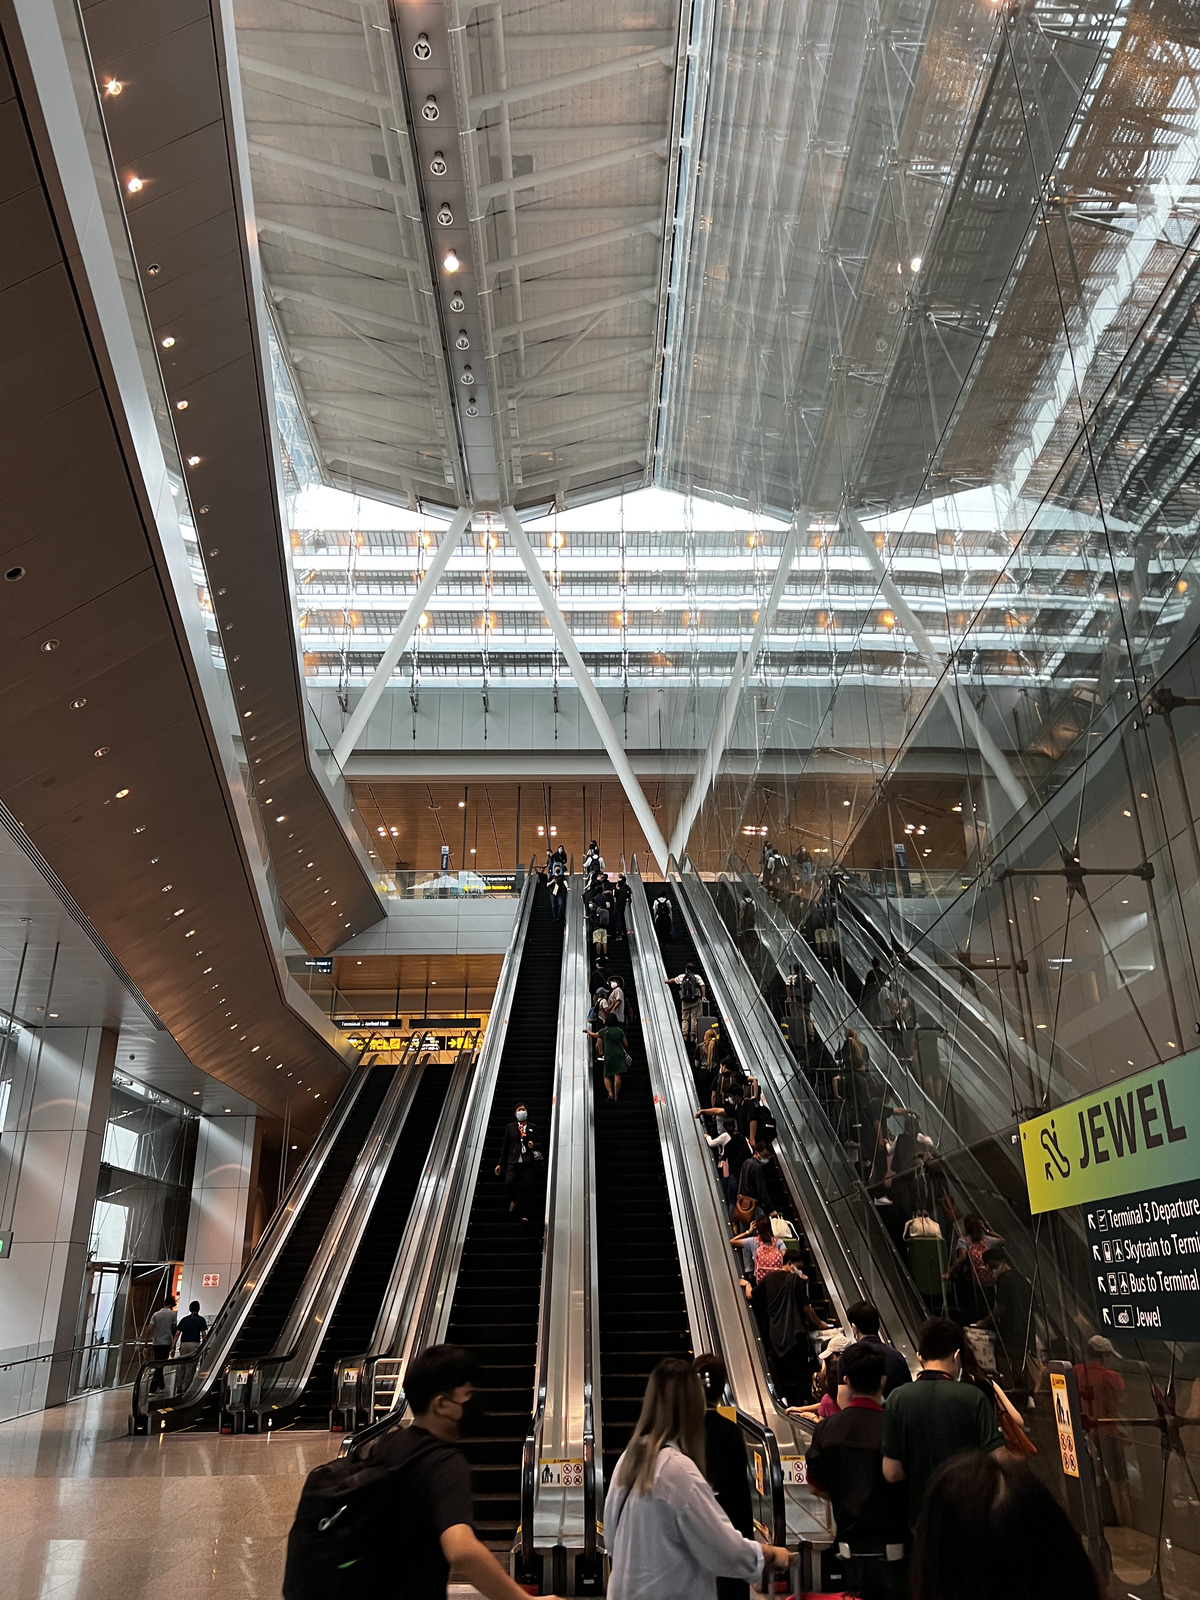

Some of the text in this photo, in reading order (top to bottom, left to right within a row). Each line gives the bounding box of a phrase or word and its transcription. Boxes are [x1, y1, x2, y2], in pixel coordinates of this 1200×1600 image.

[1078, 1079, 1187, 1169] JEWEL
[1107, 1203, 1144, 1229] Terminal
[1143, 1202, 1152, 1223] 3
[1124, 1236, 1160, 1264] Skytrain
[1159, 1237, 1172, 1257] to
[1129, 1267, 1200, 1293] Bus to Terminal
[1136, 1305, 1162, 1327] Jewel
